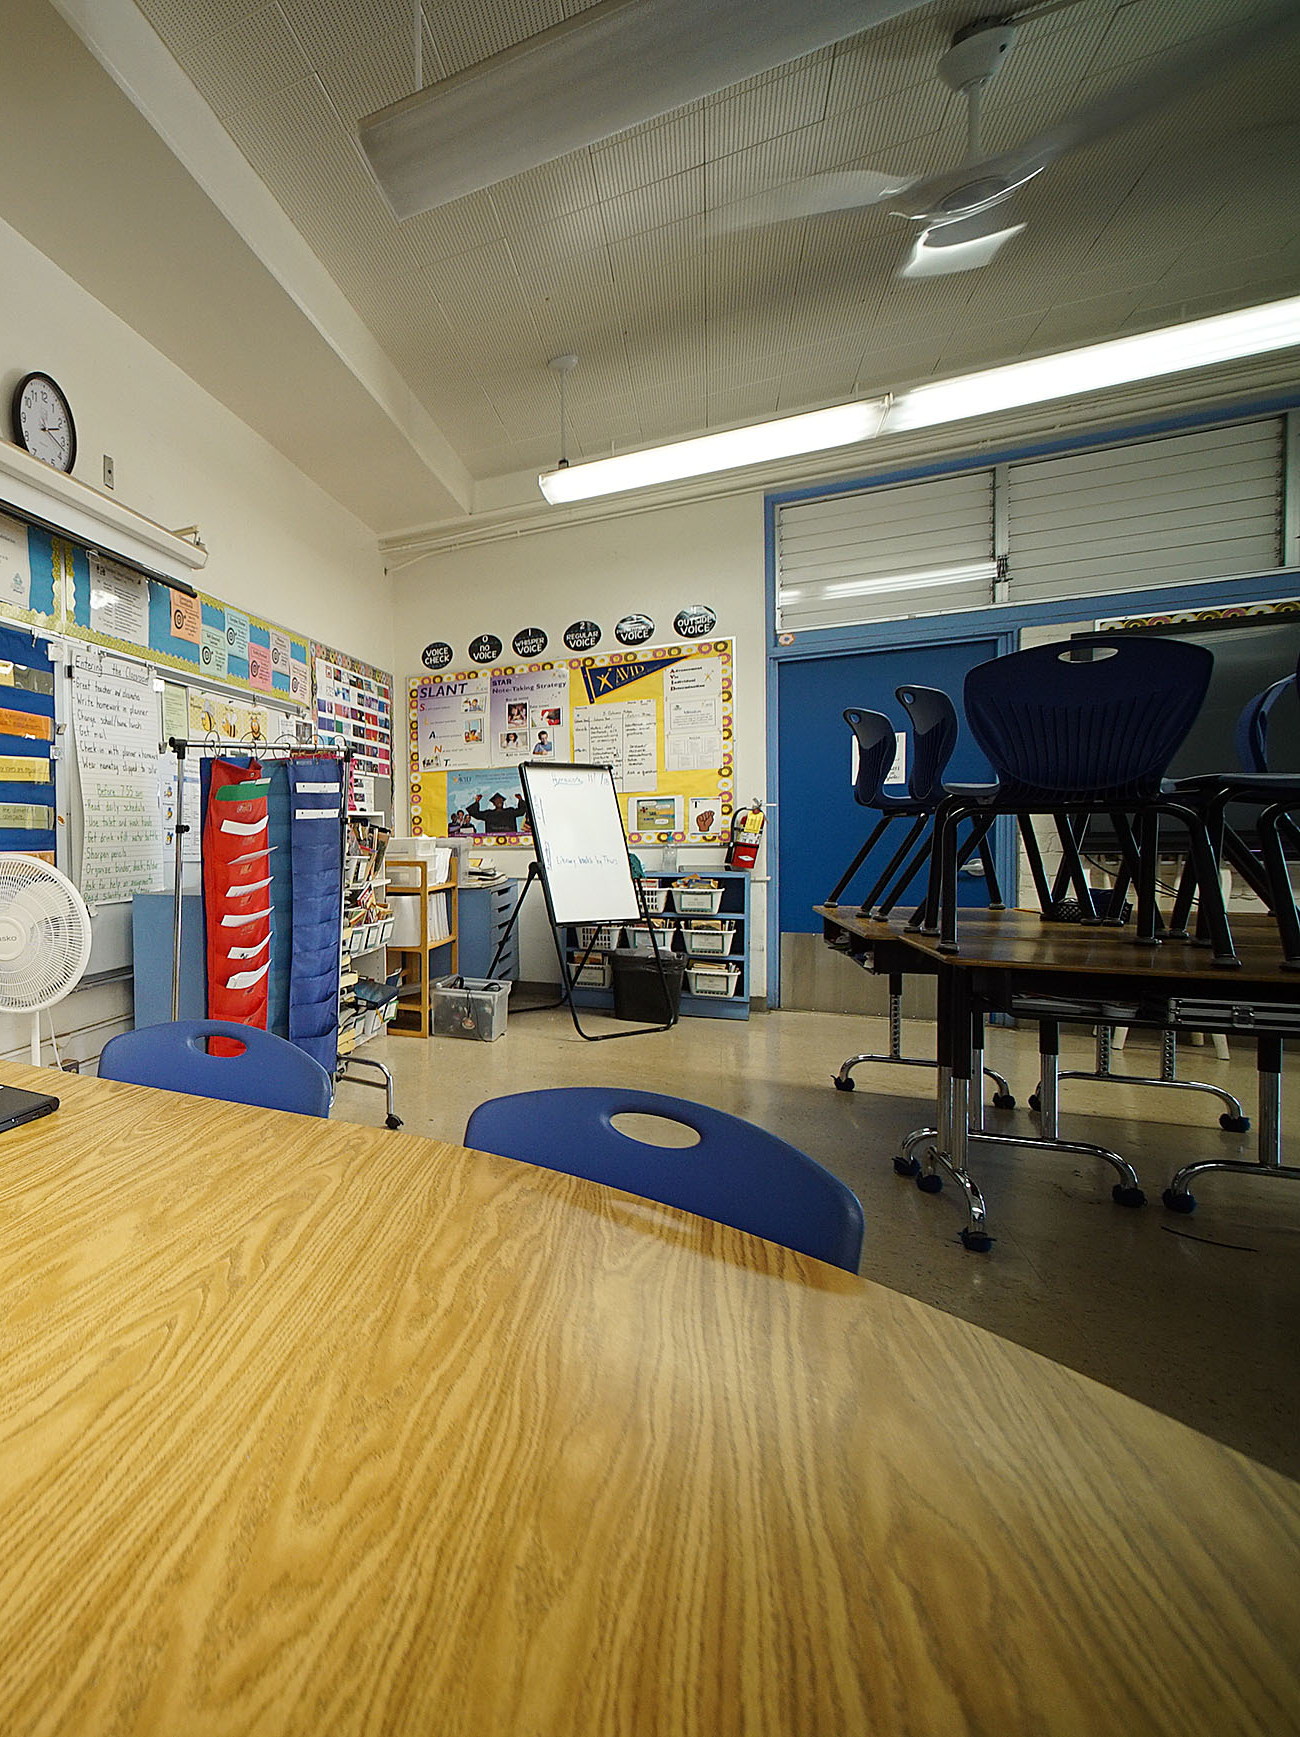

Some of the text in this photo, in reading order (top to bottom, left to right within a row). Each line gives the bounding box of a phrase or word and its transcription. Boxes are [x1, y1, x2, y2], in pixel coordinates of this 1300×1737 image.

[31, 389, 38, 402] 11
[40, 390, 48, 404] 12
[24, 396, 32, 409] 10
[21, 412, 27, 423] 9
[58, 417, 63, 429] 2
[25, 430, 30, 442] 8
[61, 436, 66, 447] 3
[579, 621, 585, 630] 2
[676, 616, 712, 629] OUTSIDE
[679, 622, 711, 636] VOICE
[565, 631, 599, 641] REGULAR
[620, 629, 650, 642] VOICE
[479, 644, 490, 652] no
[514, 636, 545, 648] WHISPER
[568, 638, 596, 649] VOICE
[425, 646, 449, 658] VOICE
[516, 643, 543, 655] VOICE
[424, 655, 450, 666] CHECK
[473, 650, 498, 661] VOICE
[112, 663, 122, 676] the
[615, 664, 645, 684] AVID
[492, 678, 512, 687] STAR
[492, 681, 567, 695] Note-Taking Strategy
[419, 682, 468, 699] SLANT
[80, 740, 97, 752] Check
[96, 783, 115, 796] Before
[86, 847, 110, 862] Sharpen
[86, 863, 111, 878] Organize
